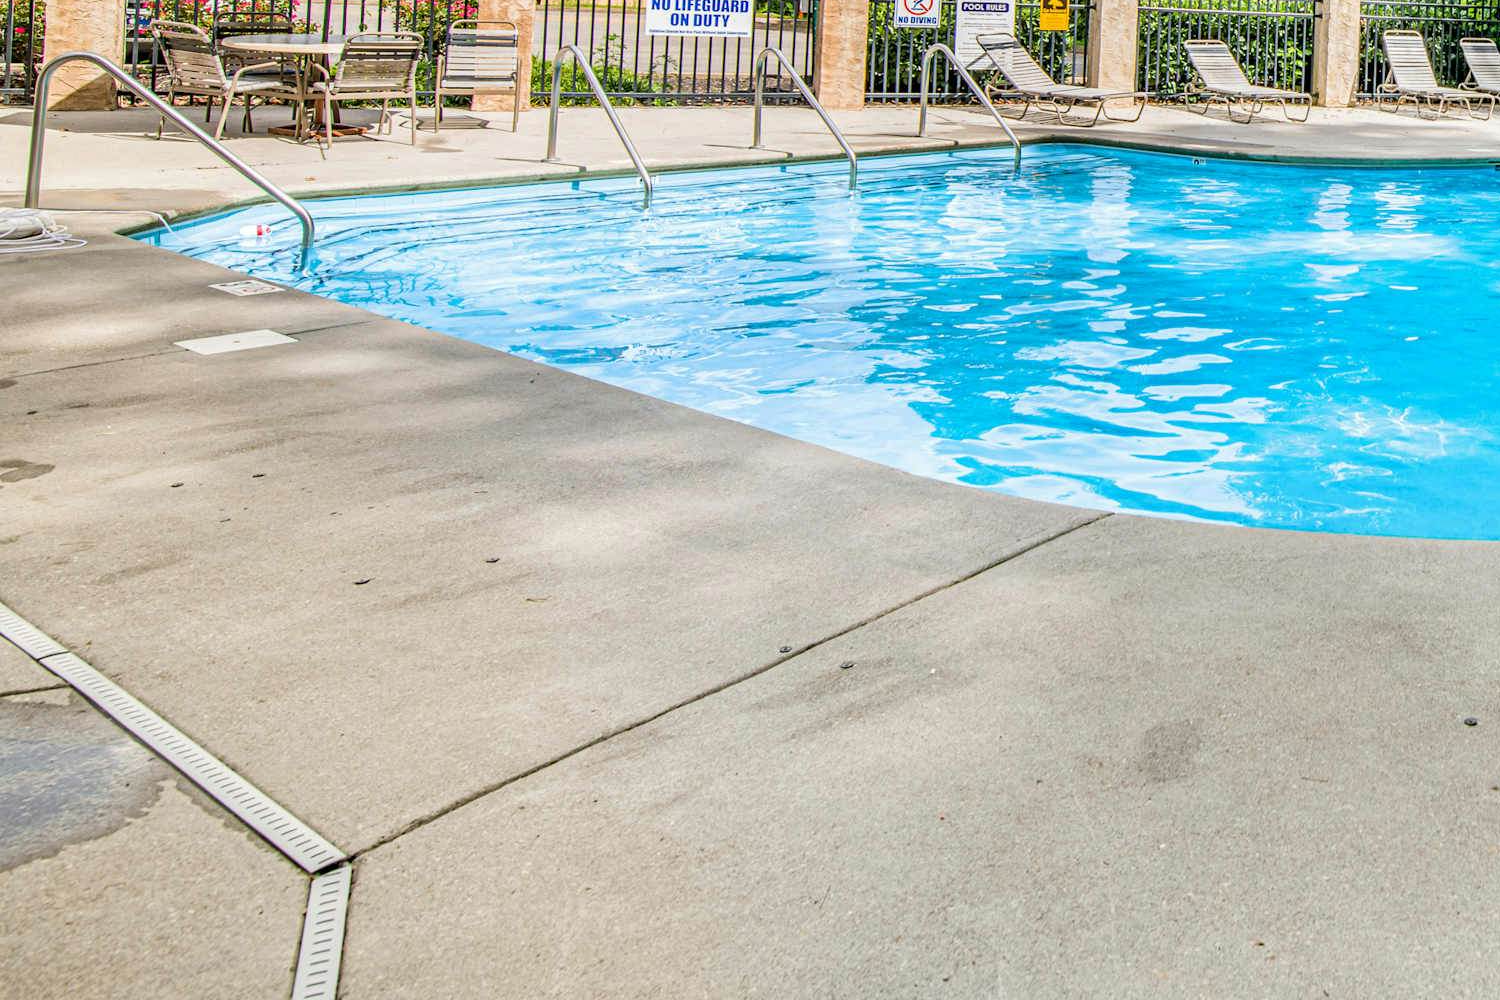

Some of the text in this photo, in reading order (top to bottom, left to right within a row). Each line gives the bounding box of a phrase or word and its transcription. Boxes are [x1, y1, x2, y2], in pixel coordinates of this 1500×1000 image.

[963, 3, 1007, 11] POOL RULES
[671, 13, 730, 27] ON DUTY
[898, 16, 937, 24] NO DIVING
